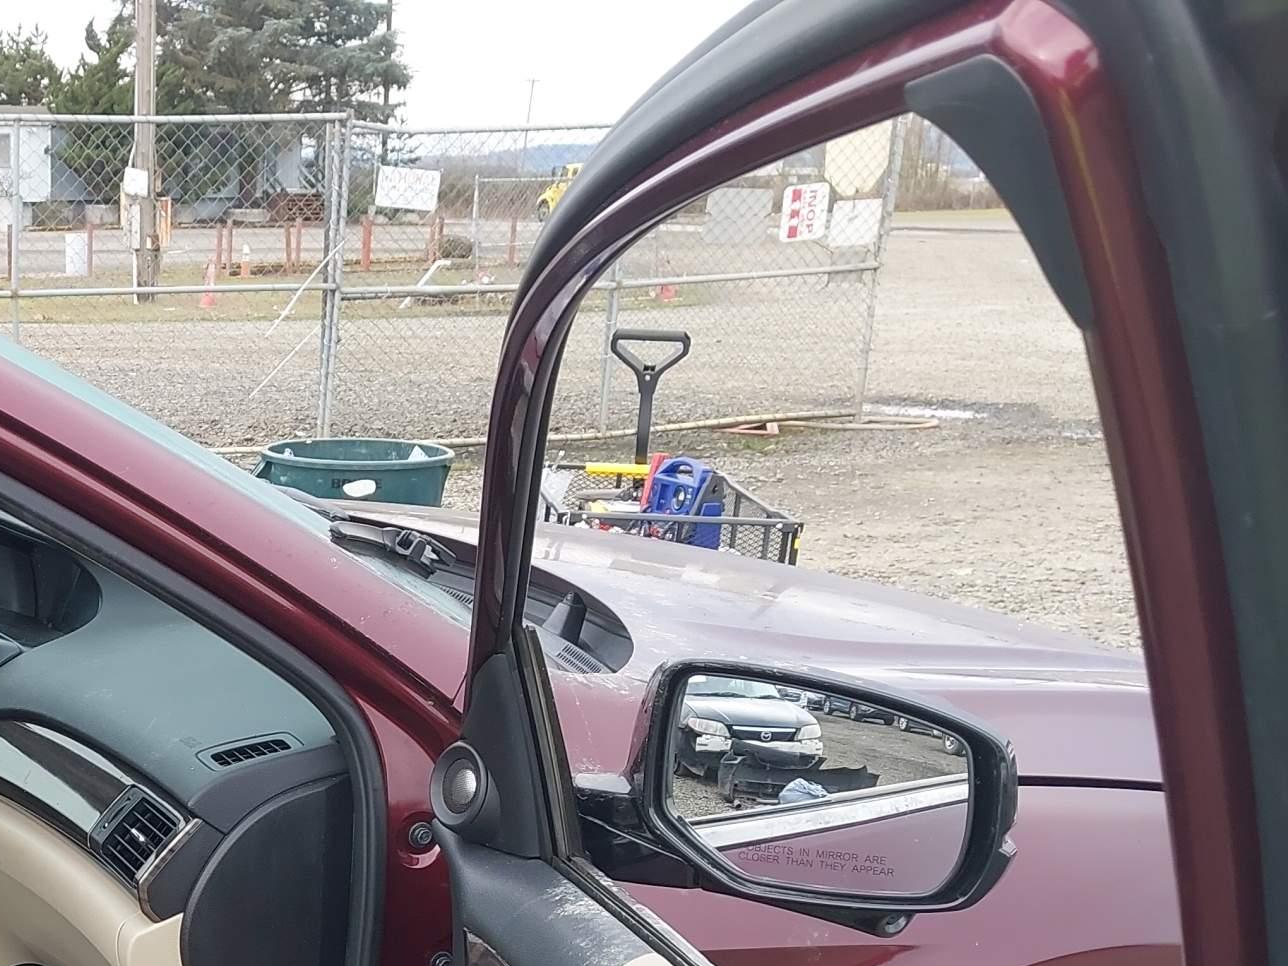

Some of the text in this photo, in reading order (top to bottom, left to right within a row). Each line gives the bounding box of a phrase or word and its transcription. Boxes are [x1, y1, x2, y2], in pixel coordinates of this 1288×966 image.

[805, 189, 818, 233] INOP
[738, 851, 895, 877] CLOSER THAN THEY APPEAR
[746, 844, 887, 866] OBJECTS IN MIRROR ARE
